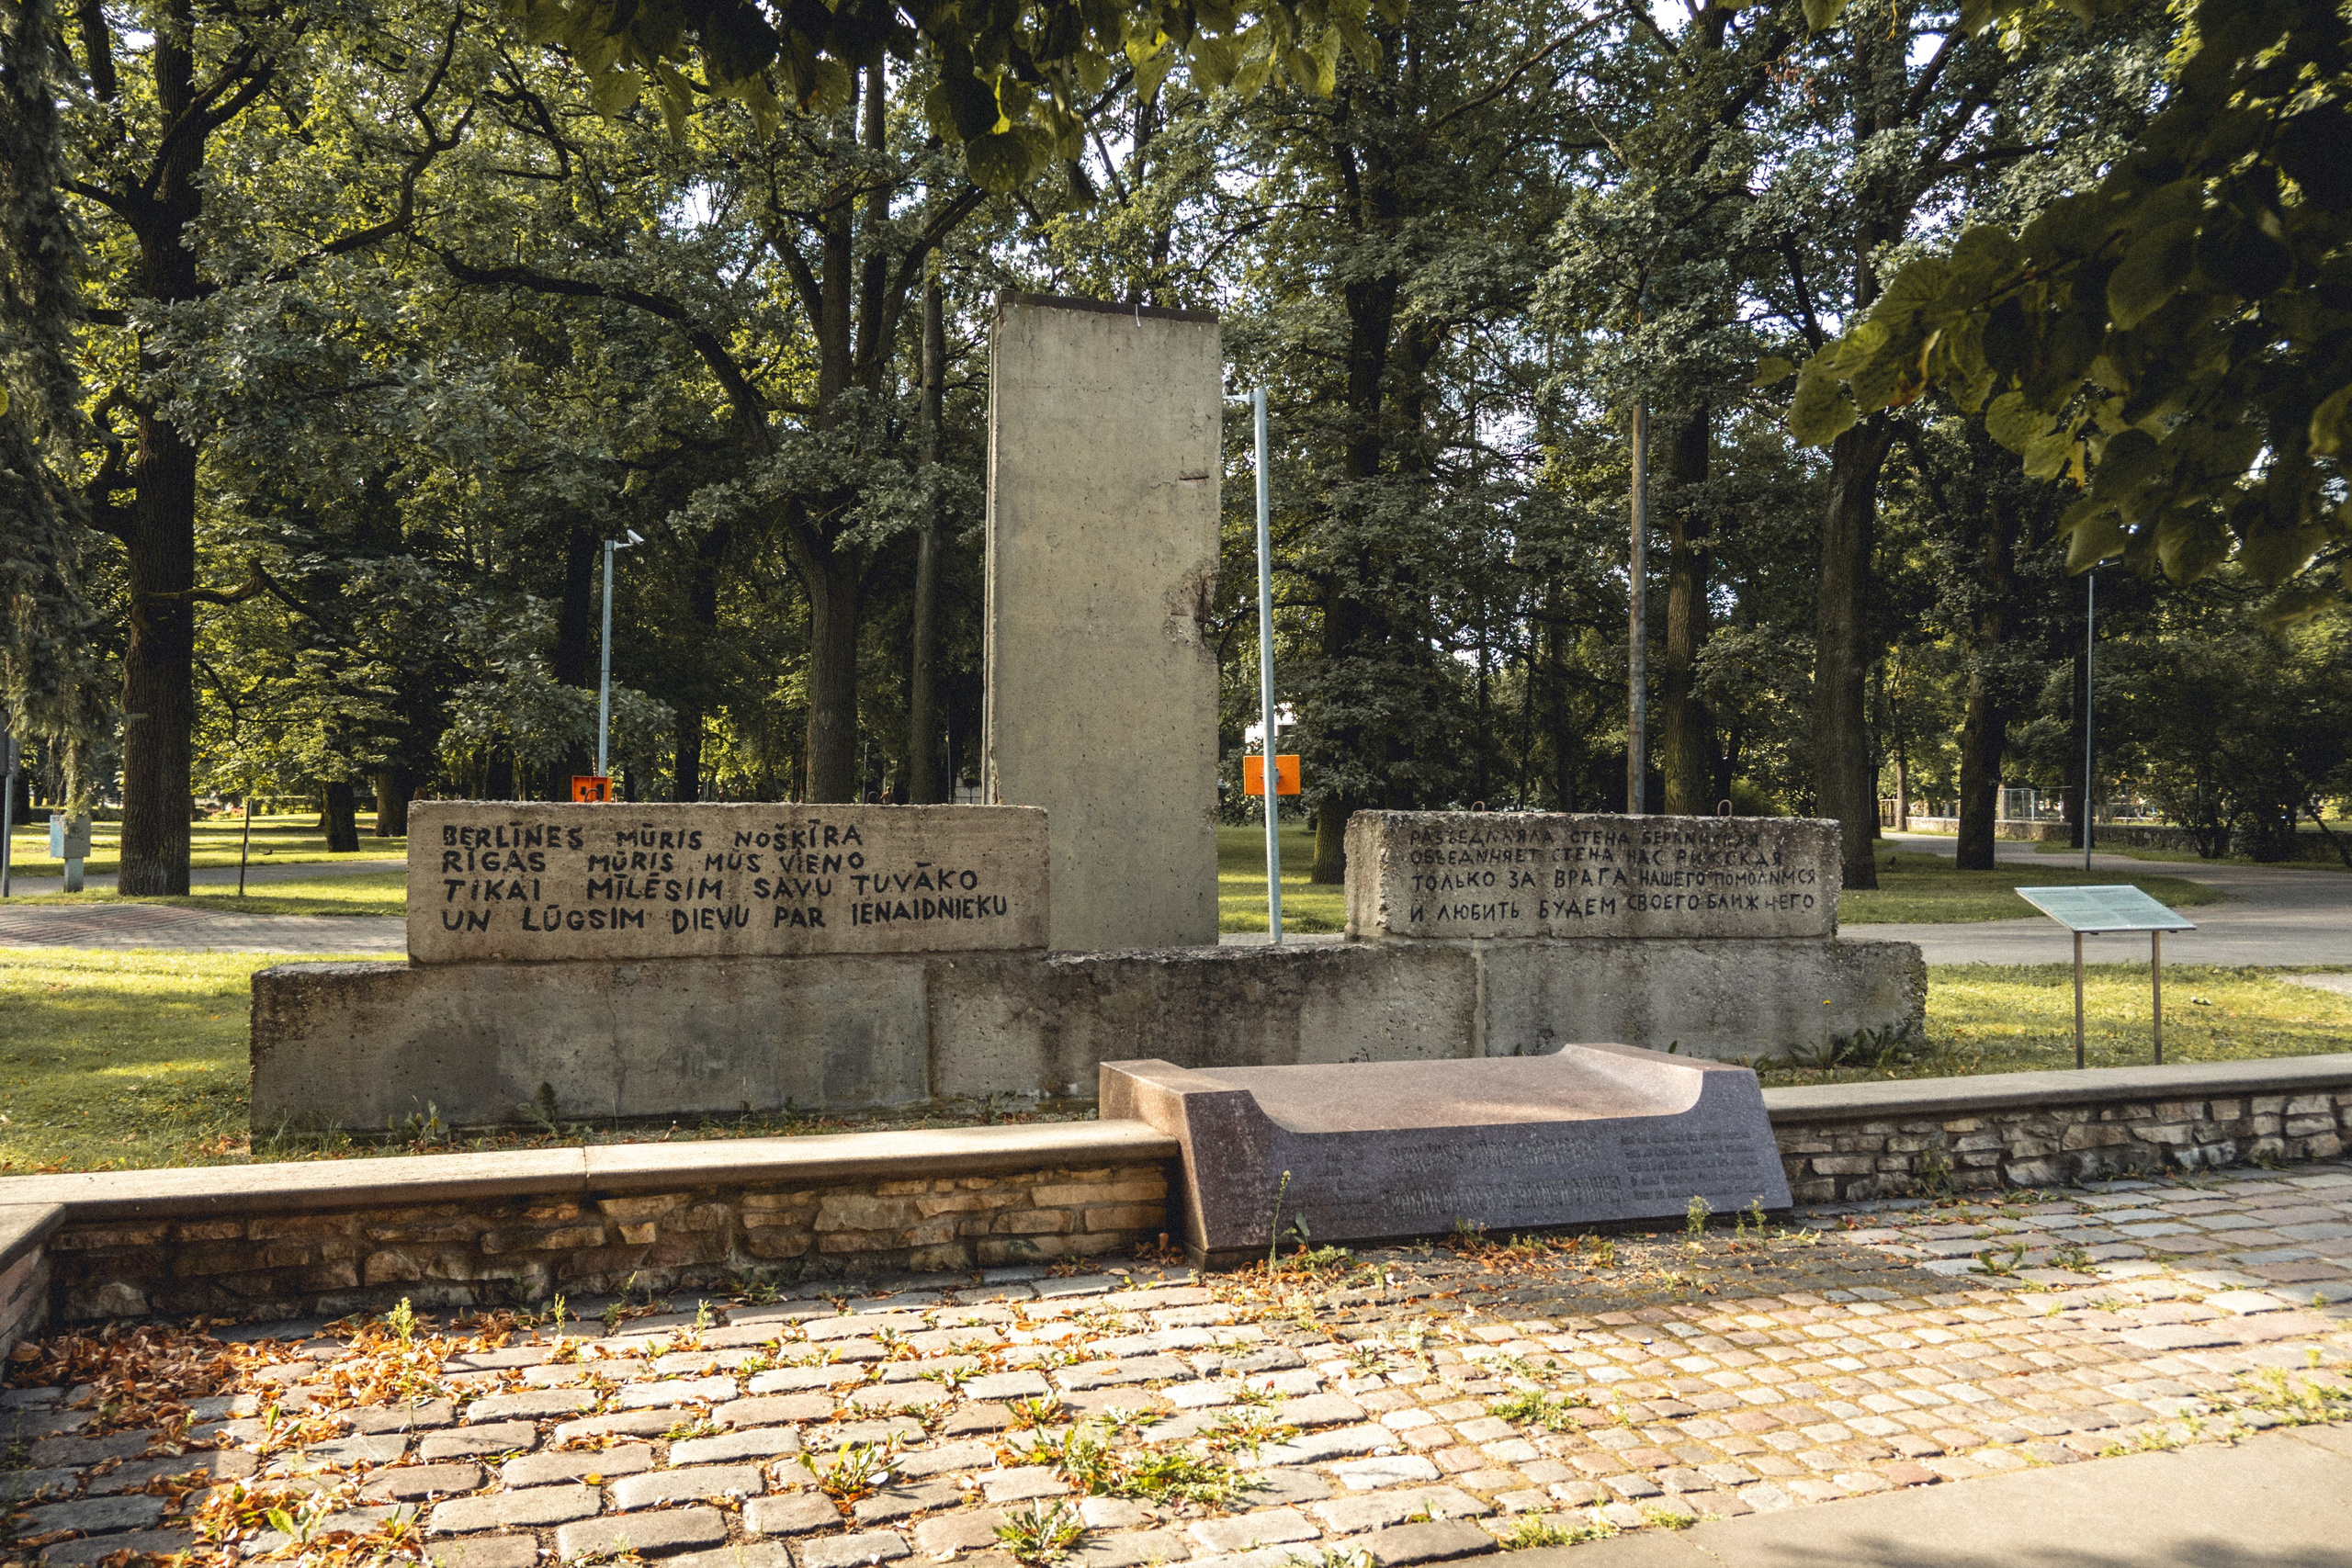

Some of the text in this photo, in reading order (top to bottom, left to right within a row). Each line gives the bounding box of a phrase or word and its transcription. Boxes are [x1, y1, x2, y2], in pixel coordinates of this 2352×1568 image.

[443, 821, 583, 850] BERLĪNES
[616, 824, 703, 850] MŪRIS
[1570, 830, 1631, 846] СТЕНА
[442, 847, 864, 874] RĪGAS MŪRIS MŪS VIENO
[1552, 847, 1614, 863] СТЕНА
[1627, 848, 1661, 865] НАС
[444, 862, 978, 902] TIKAI MĪLĒSIM SAVU TUVĀKO
[1412, 867, 1815, 892] ТОЛЬКО ЗА ВРАГА НАШЕГО ПОМОЛИМСЯ
[443, 895, 1007, 934] UN LŪGSIM DIEVU PAR IENAIDNIEKU
[1410, 905, 1424, 922] И
[1437, 901, 1520, 921] ЛЮБИТЬ
[1539, 897, 1616, 919] БУДЕМ
[1627, 894, 1700, 911] СВОЕГО
